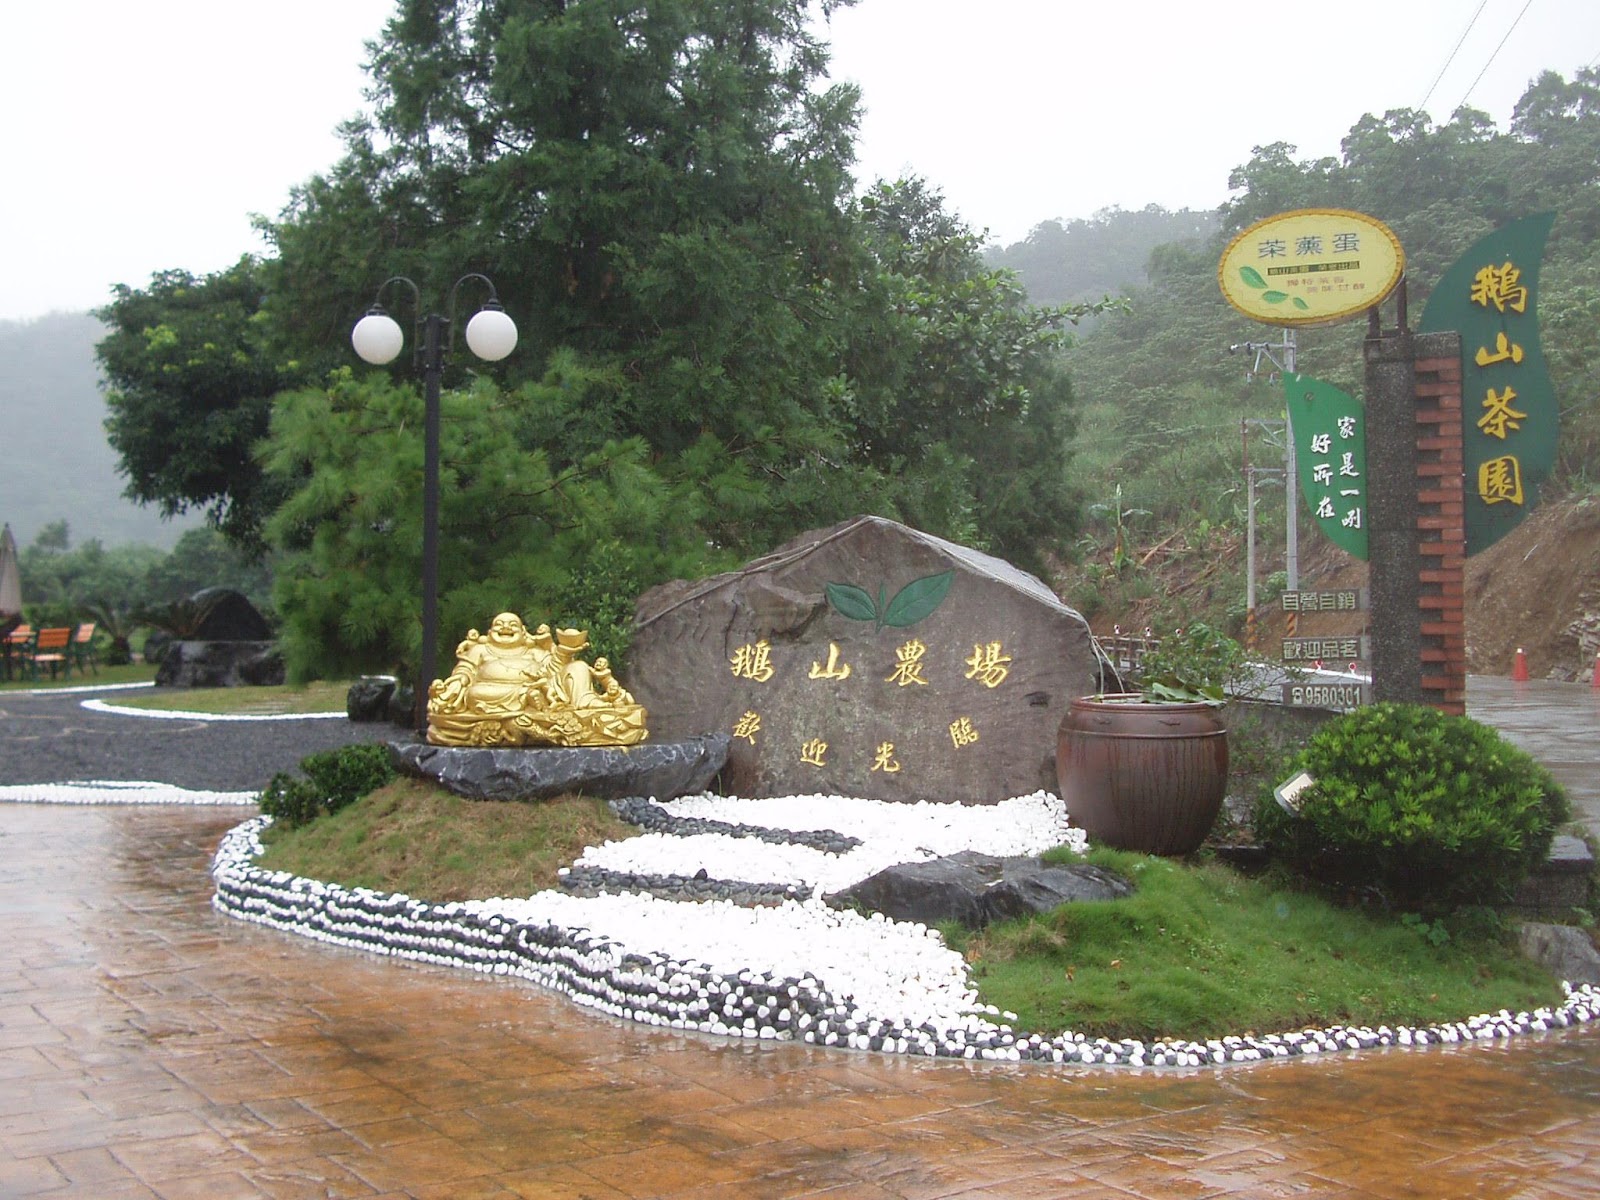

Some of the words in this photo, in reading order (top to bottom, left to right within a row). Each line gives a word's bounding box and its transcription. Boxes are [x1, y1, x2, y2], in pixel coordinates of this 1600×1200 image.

[1471, 261, 1527, 505] 鵝山茶園
[1311, 433, 1336, 518] 好所在
[1282, 591, 1356, 611] 自營自銷
[729, 638, 1012, 689] 鵝山農場
[1283, 640, 1358, 659] 歡迎品茗
[1305, 686, 1361, 705] 9580301
[732, 709, 980, 773] 歡迎光臨
